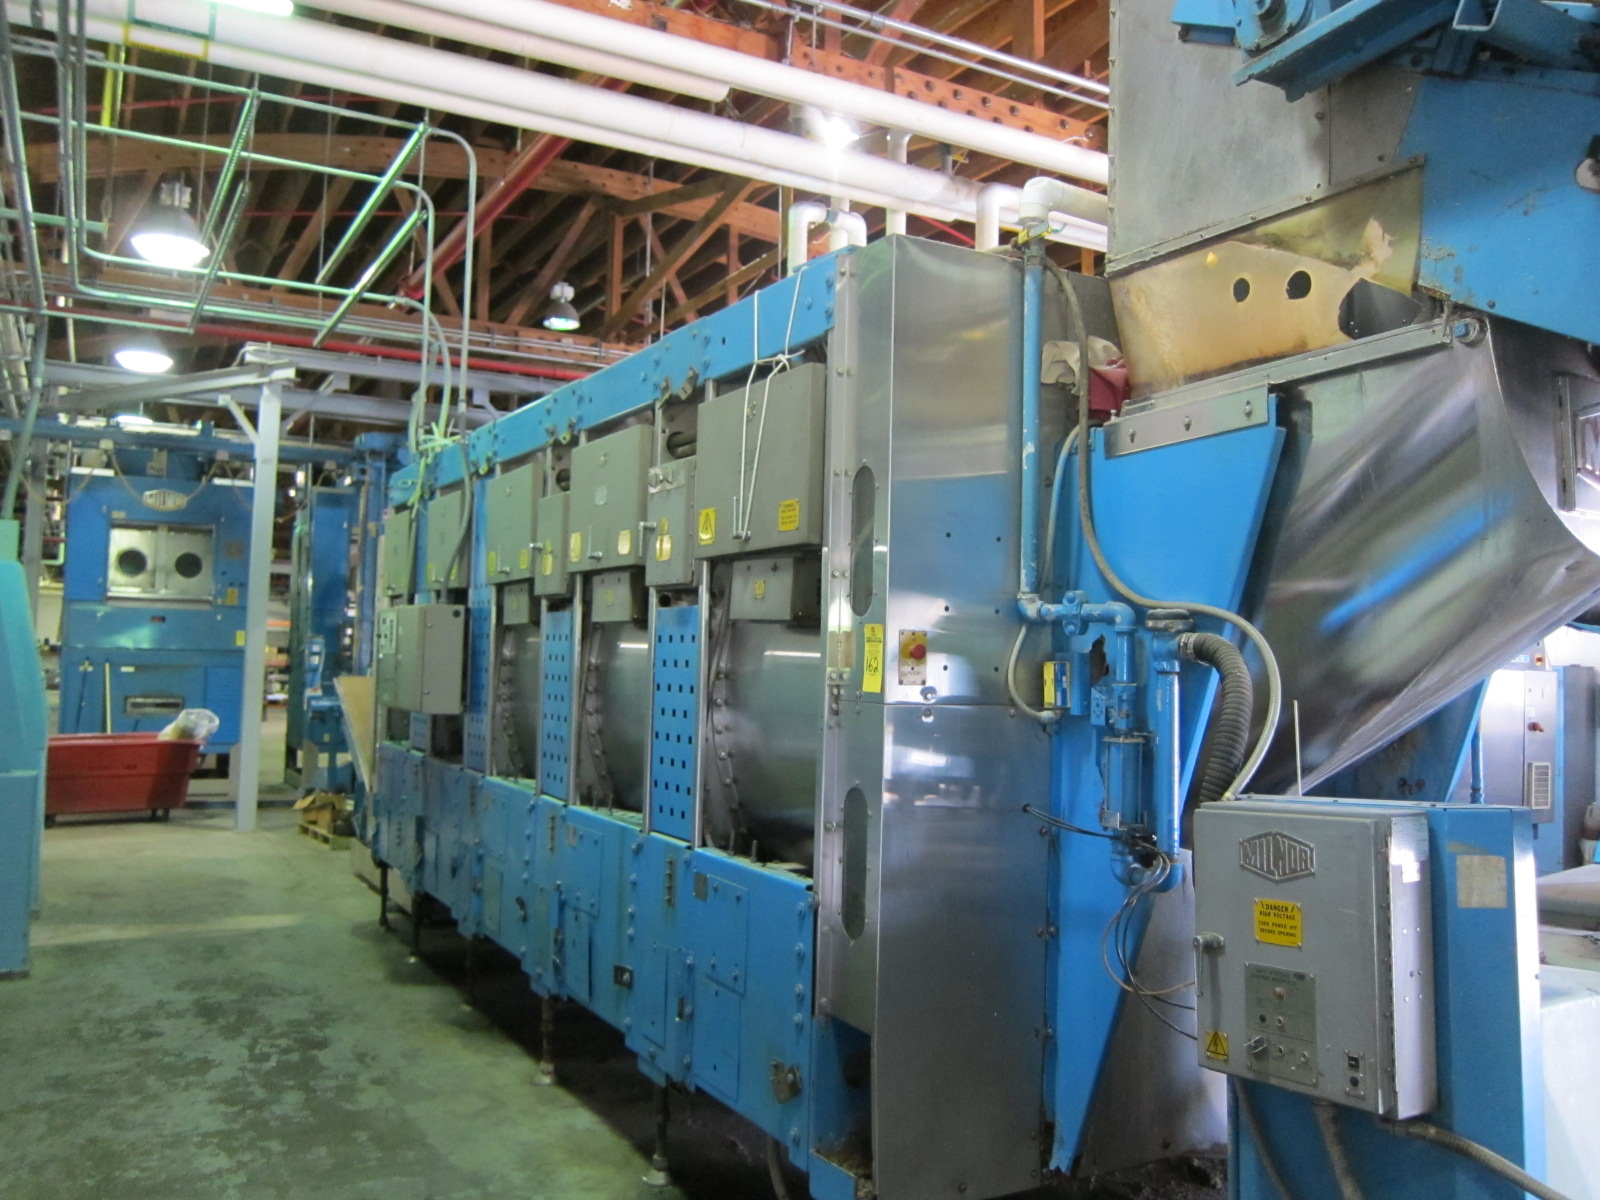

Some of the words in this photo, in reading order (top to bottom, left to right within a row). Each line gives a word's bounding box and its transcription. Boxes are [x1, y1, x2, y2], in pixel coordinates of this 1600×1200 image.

[866, 656, 879, 673] 162
[1242, 835, 1311, 877] MILNOR
[1265, 903, 1289, 913] DANGER
[1273, 912, 1296, 920] VOLTAGE
[1260, 927, 1276, 935] BEFORE
